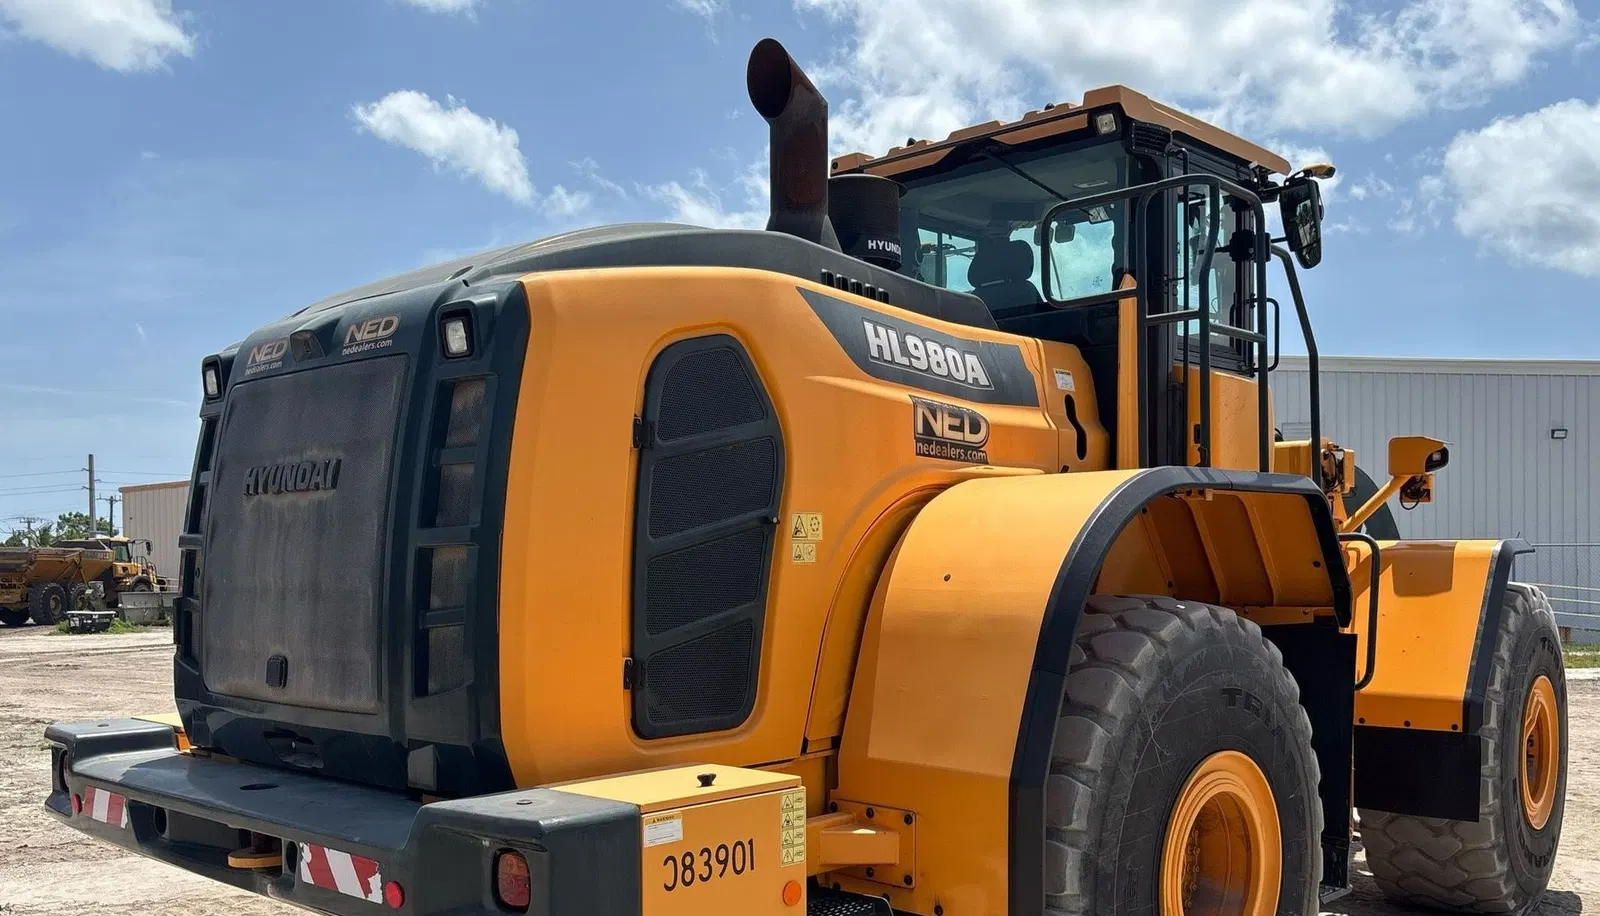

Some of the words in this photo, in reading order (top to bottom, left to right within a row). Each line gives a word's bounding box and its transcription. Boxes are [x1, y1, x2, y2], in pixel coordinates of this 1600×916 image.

[868, 239, 902, 256] HYUND
[346, 315, 400, 343] NED
[248, 340, 289, 364] NED
[342, 338, 393, 356] nedealers.com
[863, 320, 992, 388] HL980A
[245, 359, 283, 376] nedealers.com
[917, 404, 988, 445] NED
[916, 440, 988, 463] nedealers.com
[244, 459, 342, 497] HYUNDAI
